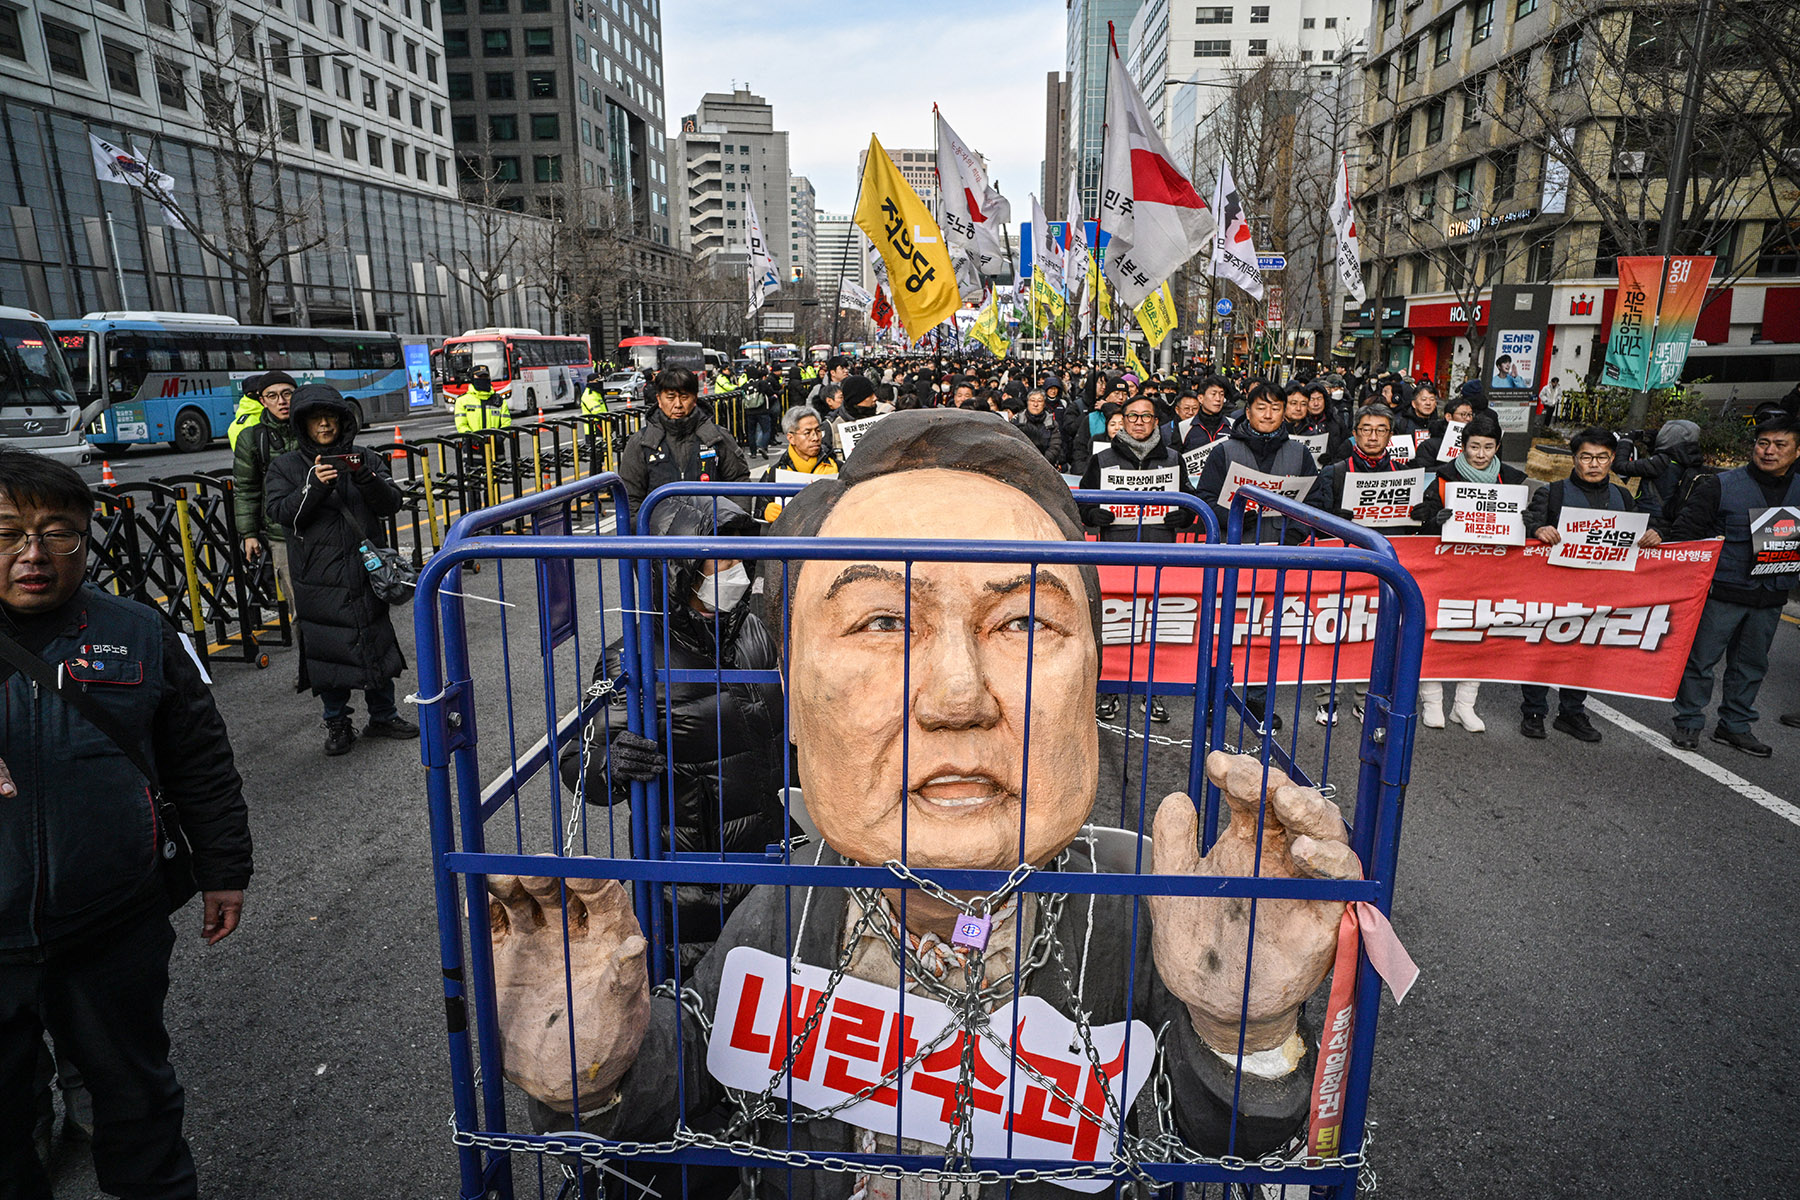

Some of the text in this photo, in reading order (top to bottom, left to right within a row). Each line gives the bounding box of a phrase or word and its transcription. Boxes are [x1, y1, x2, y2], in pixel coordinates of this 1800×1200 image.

[1103, 188, 1135, 220] 민주
[1624, 291, 1646, 313] 작은
[1144, 295, 1164, 339] 의료노조
[1450, 305, 1482, 322] HOLYS
[1620, 311, 1642, 335] 창극
[1503, 333, 1534, 344] 도시락
[1613, 335, 1643, 357] 시리즈
[1388, 446, 1409, 458] 석열
[1108, 475, 1125, 485] 독재
[1126, 475, 1154, 486] 망상에
[1233, 475, 1284, 490] 내란수괴
[1356, 480, 1379, 489] 망상과
[1380, 479, 1403, 488] 광기에
[1360, 487, 1411, 506] 윤석열
[1456, 487, 1498, 500] 민주노총
[1476, 501, 1518, 513] 이름으로
[1455, 510, 1496, 523] 윤석열을
[1566, 514, 1617, 533] 내란수괴
[1465, 522, 1510, 535] 체포한다!
[1586, 528, 1636, 548] 윤석열
[1560, 542, 1630, 562] 체포하라!
[1664, 549, 1712, 563] 비상행동
[1757, 550, 1800, 562] 국민의
[1213, 594, 1379, 645] 구속하
[1430, 598, 1671, 651] 탄핵하라
[93, 644, 128, 656] 민주노총
[729, 972, 1127, 1162] 내란수괴
[1318, 1003, 1353, 1119] 윤석열정권
